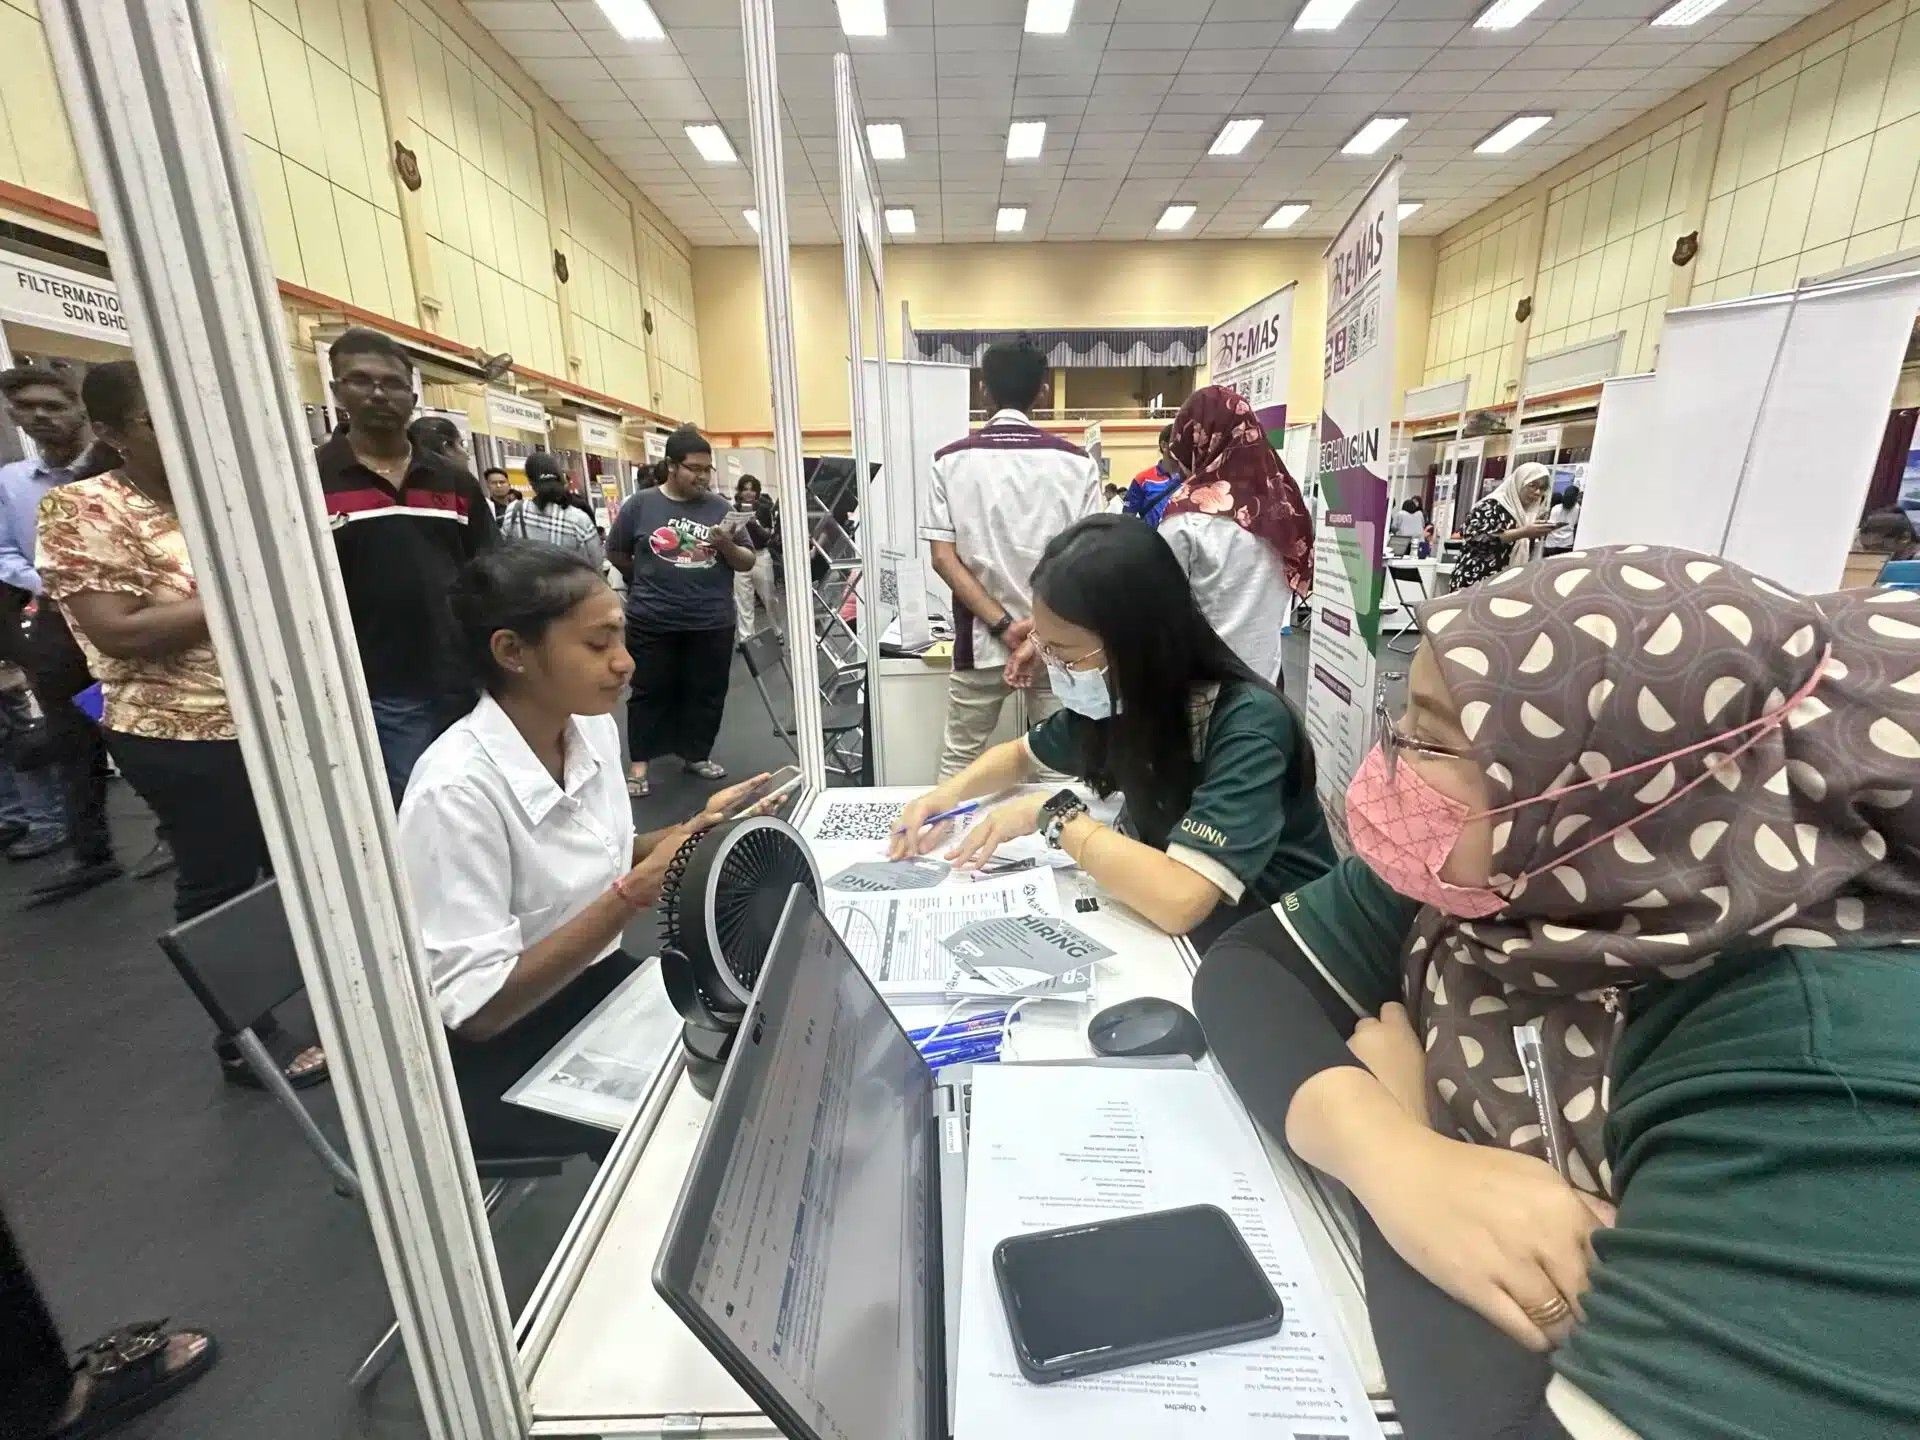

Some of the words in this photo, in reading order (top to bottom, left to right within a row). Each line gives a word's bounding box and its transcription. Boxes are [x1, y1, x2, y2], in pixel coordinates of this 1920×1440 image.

[17, 271, 119, 312] FILTERMATIO
[62, 302, 95, 323] SDN
[1235, 313, 1280, 363] E-MAS
[667, 517, 691, 532] FUN
[693, 525, 709, 539] RU
[1181, 818, 1228, 848] QUINN
[1017, 914, 1089, 958] HIRING
[1063, 928, 1080, 940] WE
[1079, 940, 1101, 953] ARE
